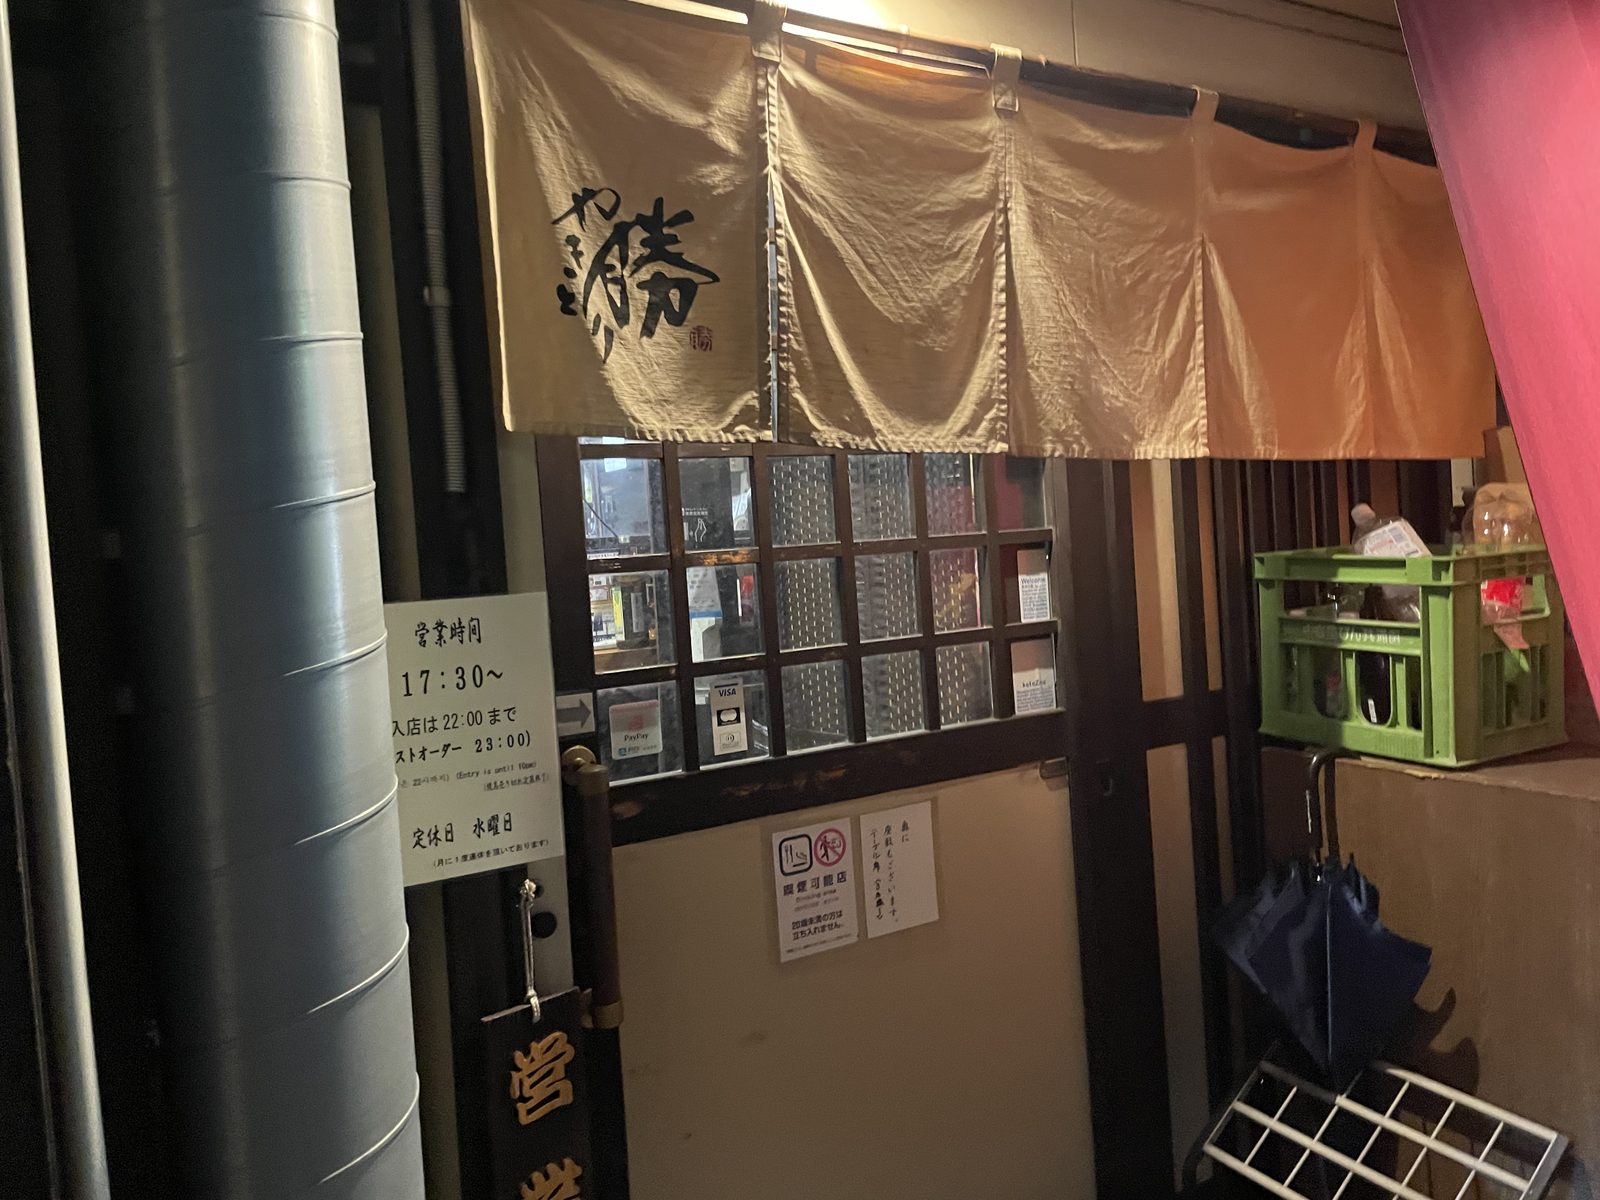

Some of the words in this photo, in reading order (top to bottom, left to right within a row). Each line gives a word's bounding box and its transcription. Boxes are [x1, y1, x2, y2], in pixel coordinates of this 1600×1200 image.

[415, 617, 482, 648] 営業時間
[718, 688, 737, 697] VISA
[624, 733, 648, 741] PayPay
[413, 823, 454, 849] 定休日
[473, 812, 512, 839] 水曜日
